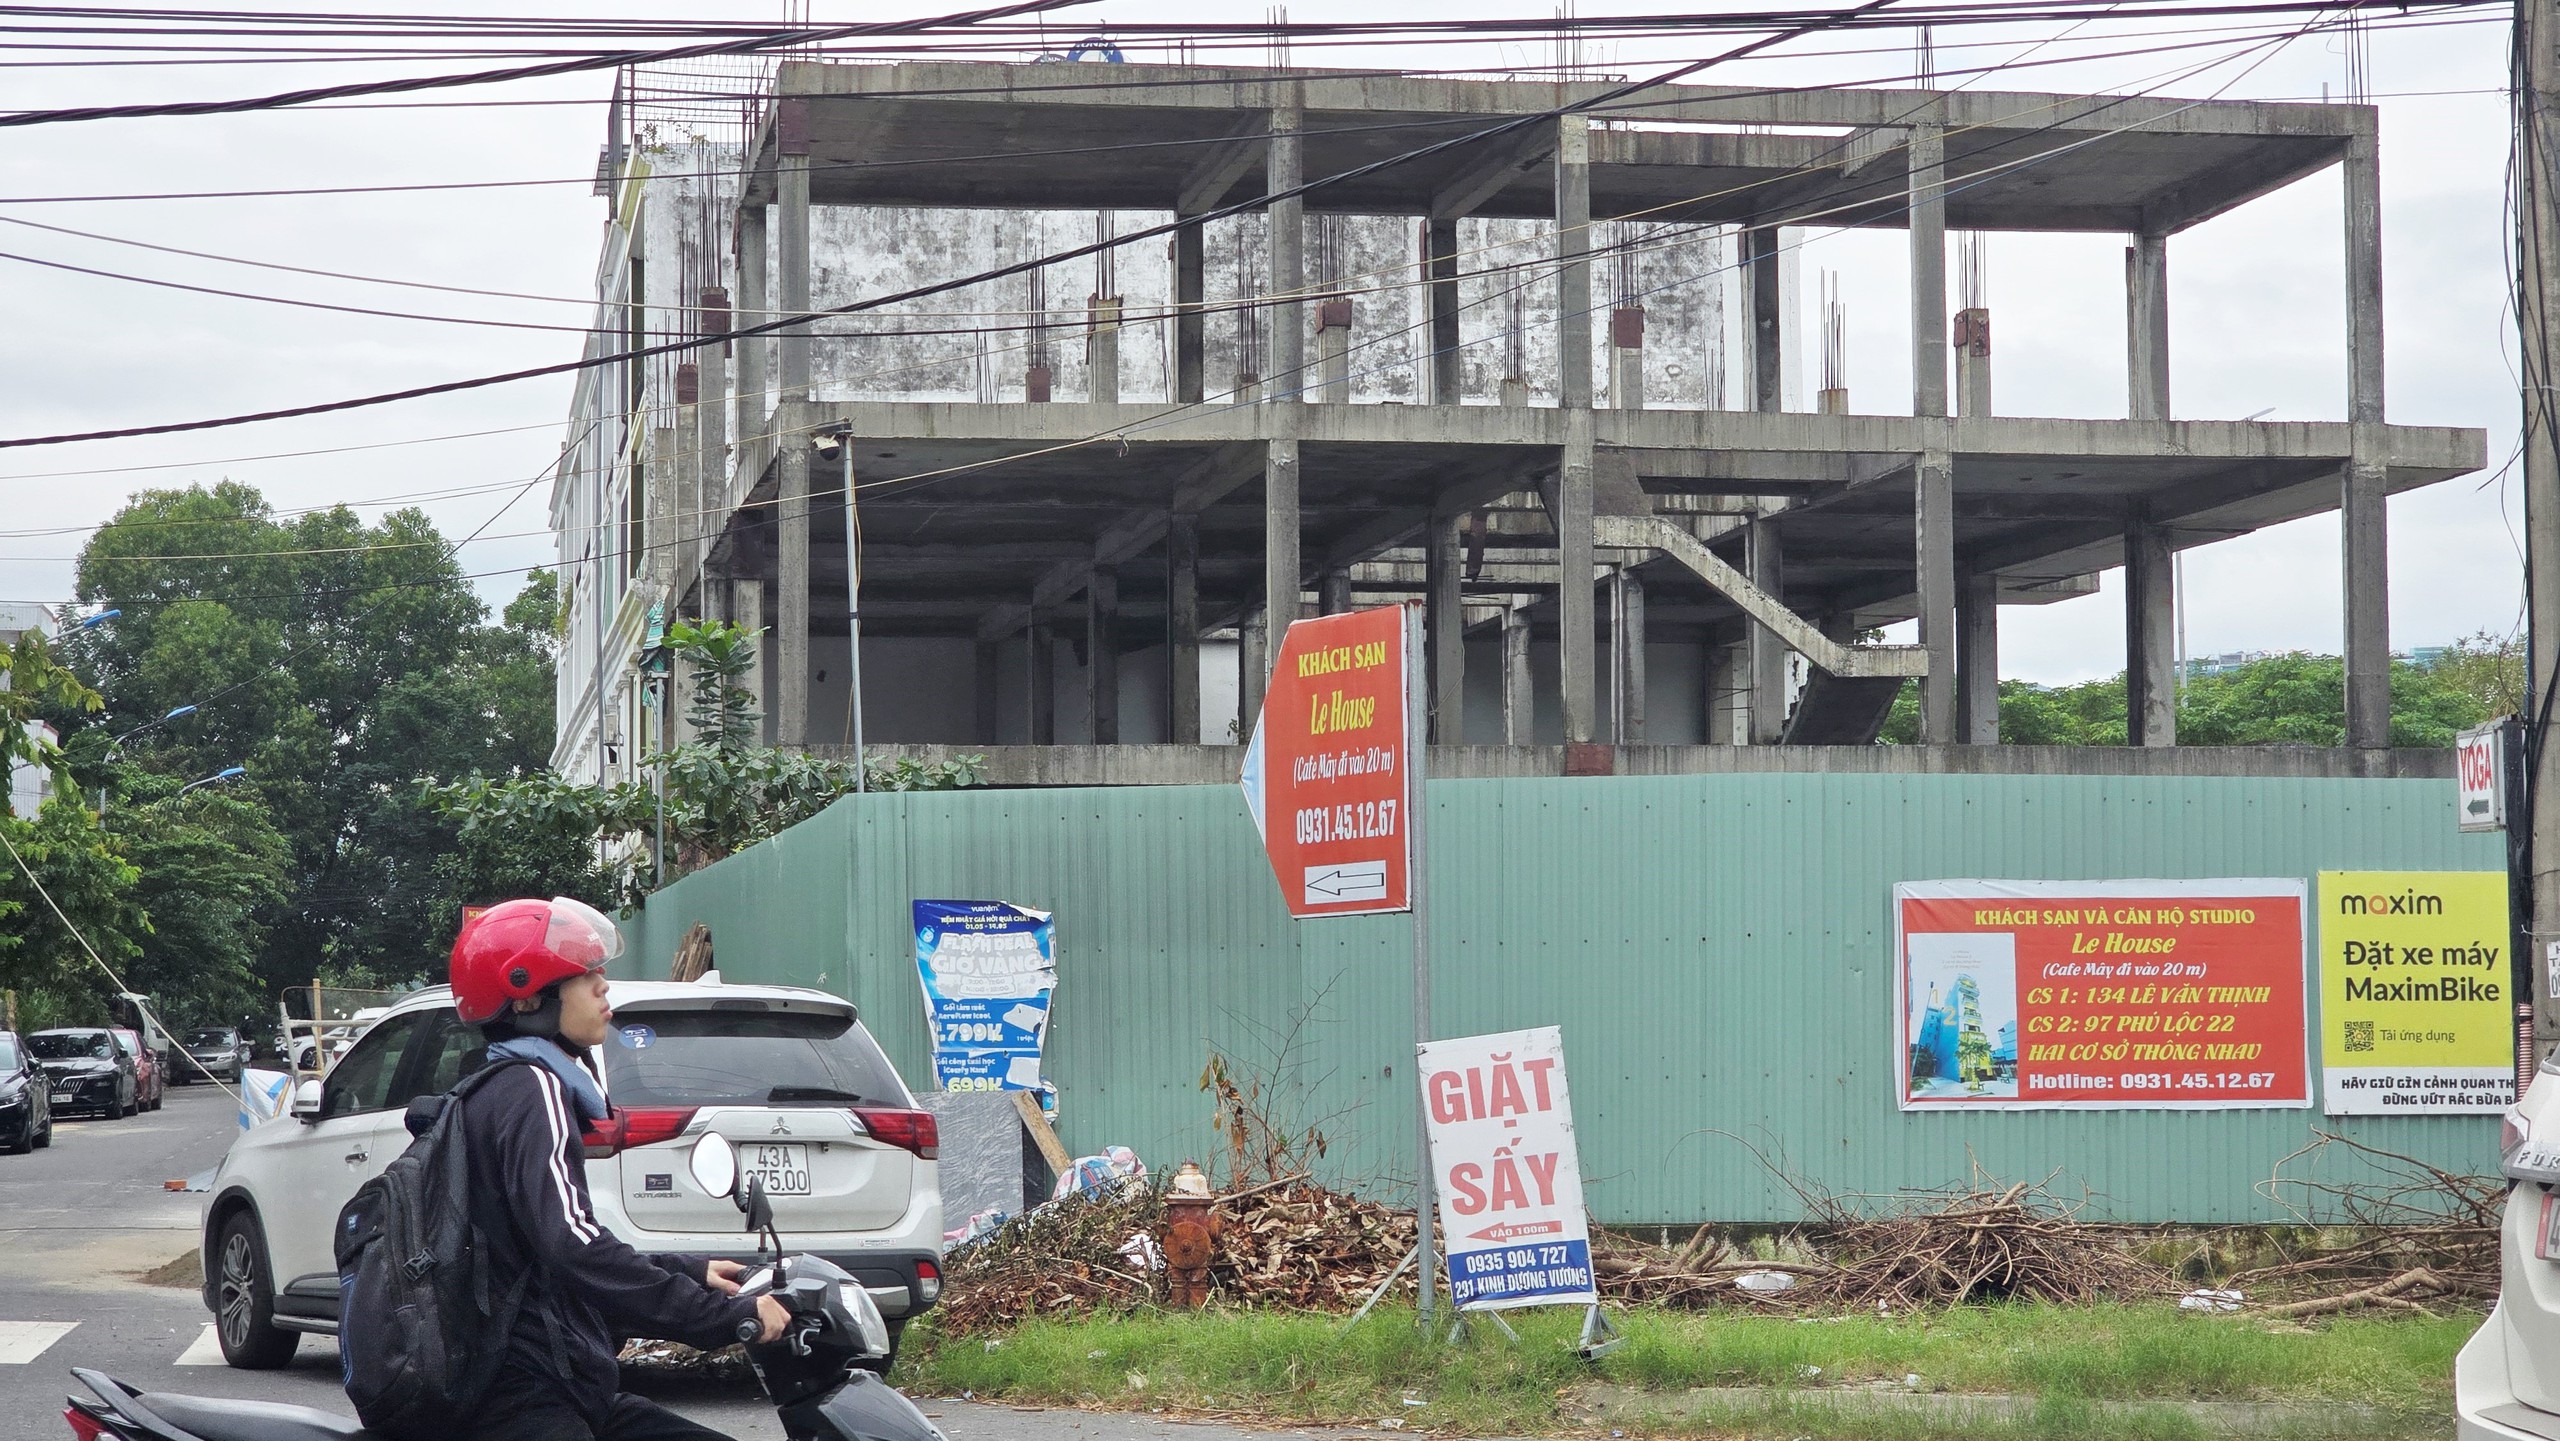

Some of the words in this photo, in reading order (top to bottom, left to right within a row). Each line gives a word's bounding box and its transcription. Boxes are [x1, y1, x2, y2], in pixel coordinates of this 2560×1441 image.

[1298, 644, 1351, 678] KHÁCH
[1354, 640, 1386, 673] SẠN
[1311, 693, 1328, 736] Le
[1330, 689, 1375, 733] House
[1293, 754, 1317, 790] (Cafe
[1317, 751, 1337, 785] Mây
[1338, 749, 1348, 777] đi
[1349, 746, 1365, 776] vào
[1366, 746, 1380, 774] 20
[1380, 743, 1395, 778] m)
[2459, 742, 2493, 793] YOGA
[1296, 799, 1397, 845] 0931.45.12.67
[2341, 887, 2443, 915] maxim
[1974, 906, 2038, 926] KHÁCH
[2043, 909, 2079, 928] SẠN
[2083, 906, 2110, 925] VÀ
[2114, 906, 2151, 925] CĂN
[2156, 906, 2185, 928] HỘ
[2189, 909, 2256, 925] STUDIO
[994, 935, 1035, 950] DEAL
[2072, 932, 2100, 954] Le
[2104, 932, 2177, 954] House
[978, 951, 1041, 974] VÀNG
[2343, 940, 2395, 972] Đặt
[2401, 947, 2434, 966] xe
[2442, 940, 2500, 971] máy
[2042, 962, 2082, 980] (Cafe
[2083, 962, 2114, 979] Mây
[2115, 962, 2132, 976] đi
[2134, 961, 2160, 976] vào
[2162, 962, 2183, 976] 20
[2185, 962, 2207, 980] m)
[2027, 987, 2054, 1005] CS
[2059, 987, 2078, 1004] 1:
[2087, 987, 2126, 1004] 134
[2129, 983, 2157, 1004] LÊ
[2160, 983, 2204, 1004] VĂN
[2207, 986, 2271, 1008] THỊNH
[2345, 976, 2500, 1002] MaximBike
[1942, 1006, 1957, 1026] 2
[2027, 1015, 2054, 1033] CS
[2056, 1015, 2079, 1033] 2:
[2083, 1015, 2114, 1033] 97
[2116, 1011, 2160, 1033] PHÚ
[2163, 1011, 2204, 1037] LỘC
[2206, 1015, 2235, 1032] 22
[634, 1036, 646, 1049] 2
[2380, 1029, 2396, 1041] Tải
[2399, 1029, 2422, 1043] ứng
[2425, 1029, 2455, 1044] dụng
[2028, 1044, 2066, 1061] HAI
[2069, 1042, 2099, 1061] CƠ
[2100, 1038, 2130, 1061] SỞ
[2133, 1039, 2201, 1061] THÔNG
[2204, 1043, 2262, 1061] NHAU
[1428, 1051, 1555, 1128] GIẶT
[2029, 1073, 2114, 1090] Hotline:
[2120, 1072, 2275, 1089] 0931.45.12.67
[2341, 1076, 2367, 1089] HÃY
[2370, 1076, 2395, 1089] GIỮ
[2397, 1076, 2421, 1089] GÌN
[2424, 1075, 2457, 1089] CẢNH
[2460, 1078, 2496, 1090] QUAN
[2382, 1092, 2418, 1105] ĐỪNG
[2420, 1092, 2446, 1105] VỨT
[2448, 1092, 2474, 1105] RÁC
[2476, 1092, 2501, 1106] BỪA
[2504, 1095, 2515, 1106] B
[757, 1145, 793, 1168] 43A
[1449, 1136, 1559, 1216] SẤY
[1516, 1224, 1549, 1236] 100m
[1465, 1252, 1504, 1274] 0935
[1507, 1249, 1537, 1269] 904
[1539, 1245, 1568, 1266] 727
[1477, 1274, 1506, 1295] KINH
[1508, 1269, 1547, 1292] DƯƠNG
[1548, 1266, 1588, 1288] VƯƠNG
